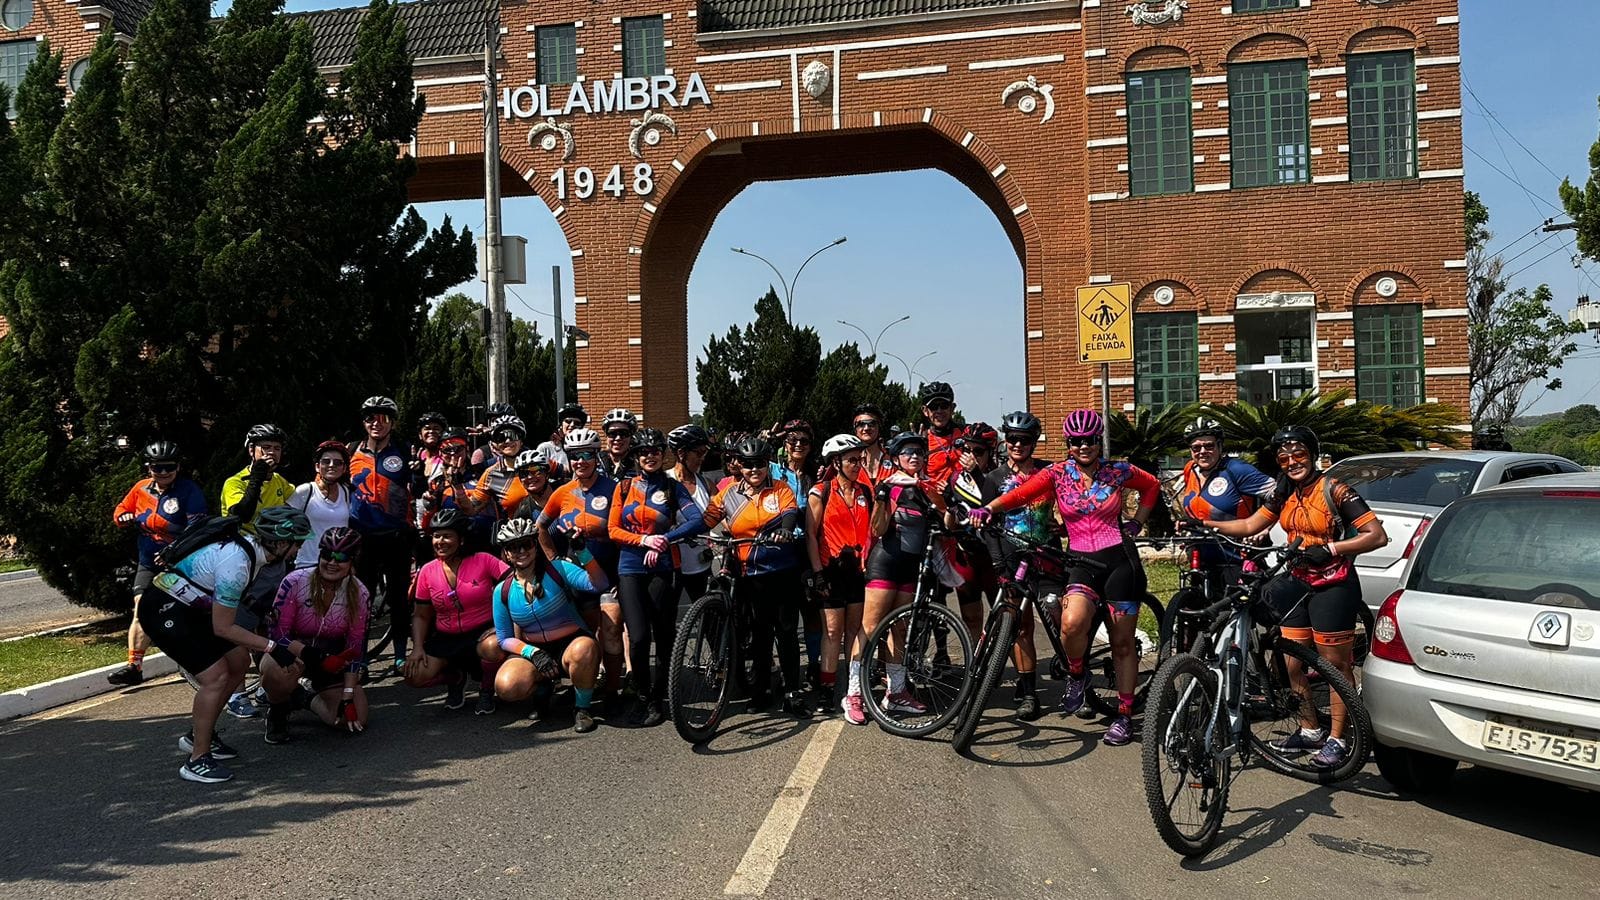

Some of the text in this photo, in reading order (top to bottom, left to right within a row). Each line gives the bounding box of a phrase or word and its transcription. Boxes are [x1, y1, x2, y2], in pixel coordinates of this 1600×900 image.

[551, 163, 653, 199] 1948
[1091, 333, 1118, 342] FAIXA
[1085, 341, 1126, 351] ELEVADA
